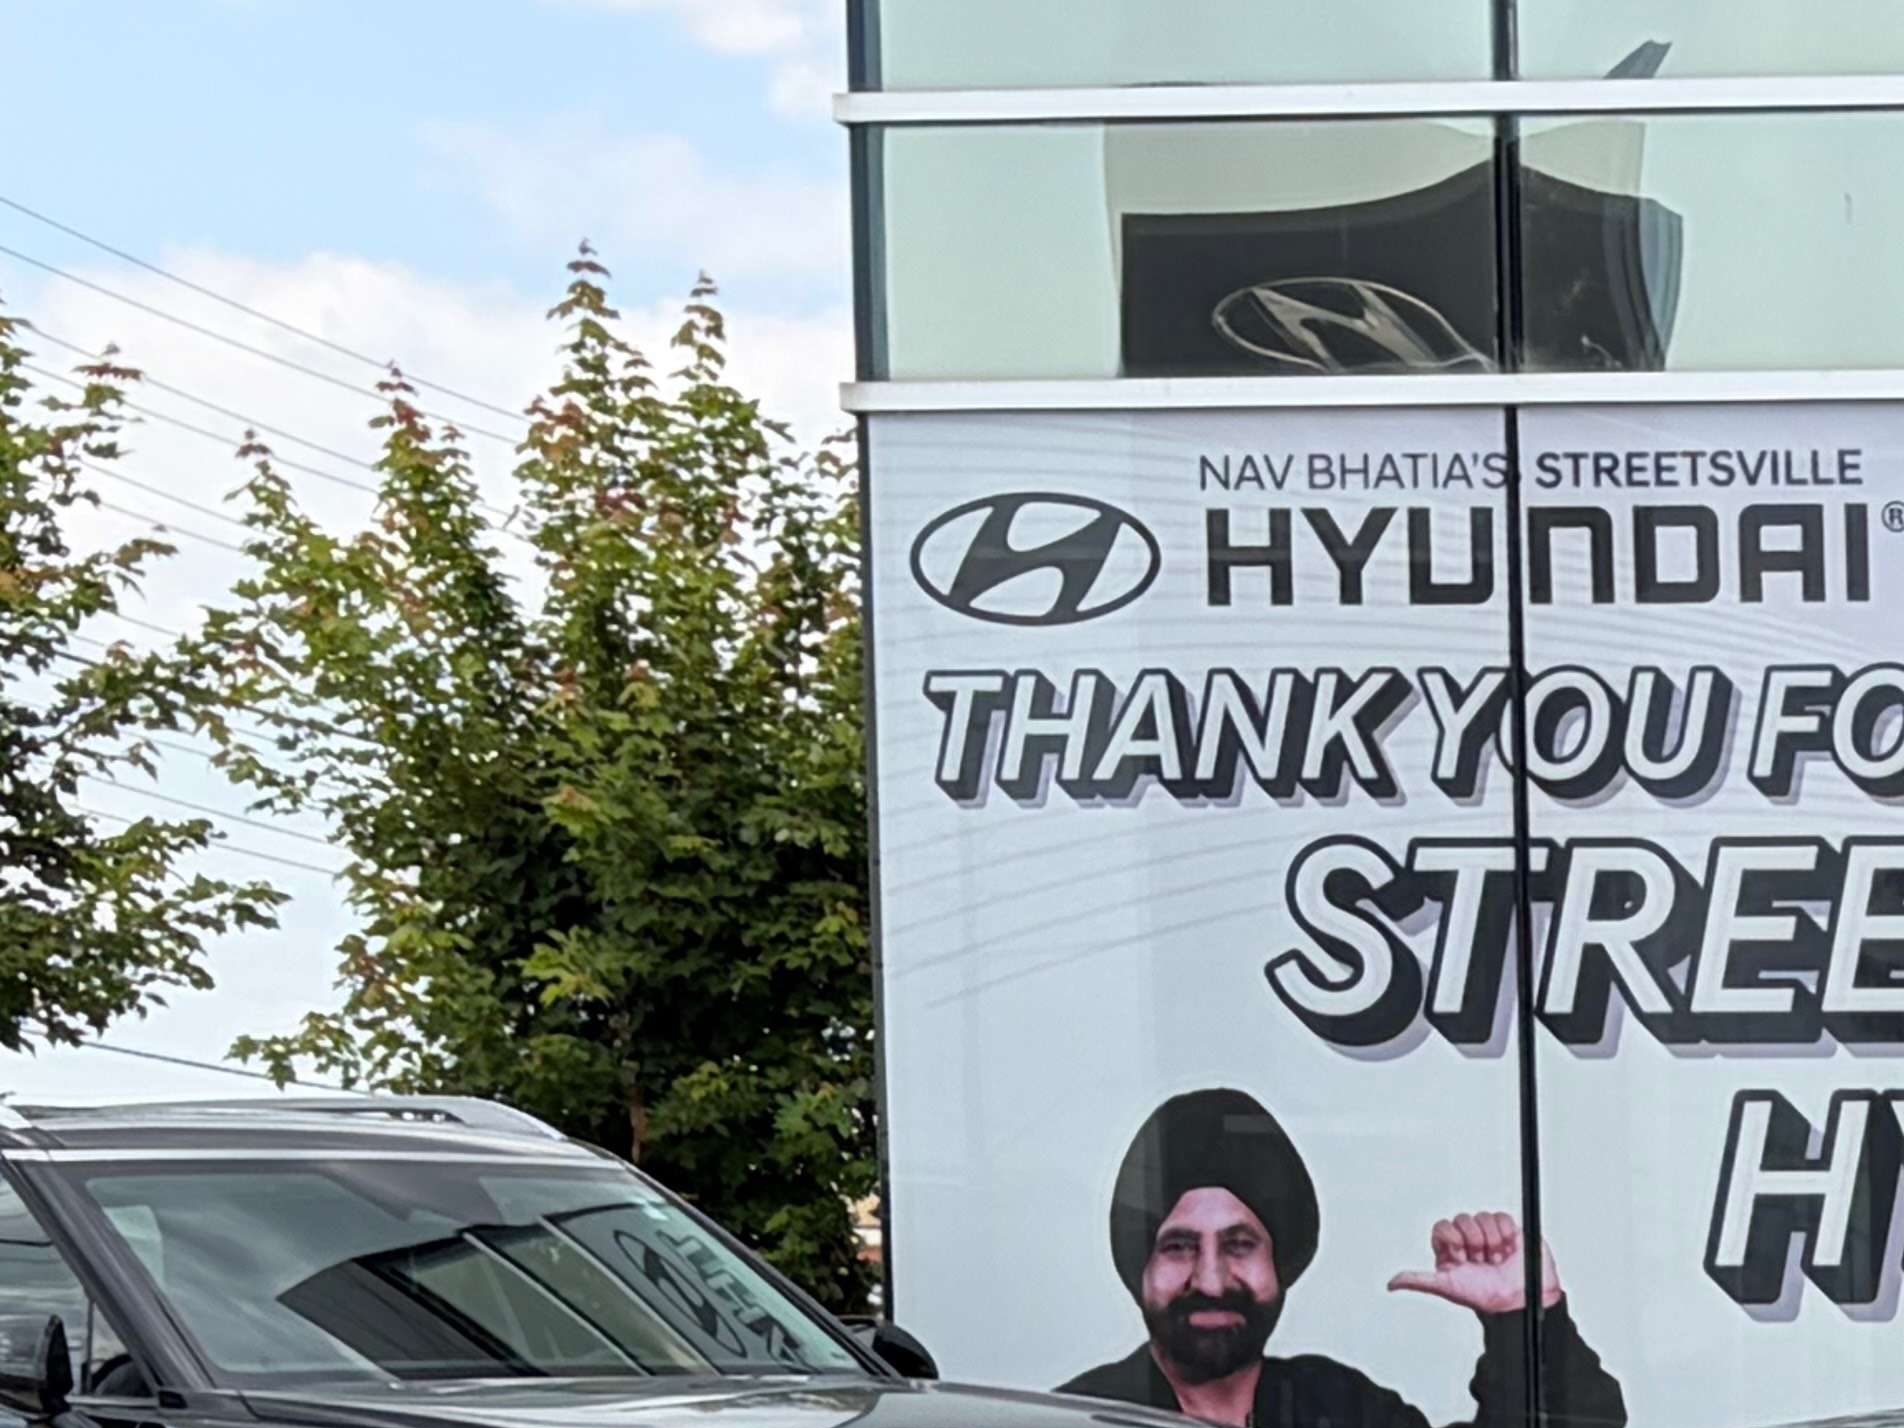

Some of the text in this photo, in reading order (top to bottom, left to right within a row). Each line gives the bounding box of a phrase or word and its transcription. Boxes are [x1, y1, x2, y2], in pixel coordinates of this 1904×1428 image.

[1199, 449, 1864, 490] NAV BHATIA'S STREETSVILLE
[924, 667, 1412, 800] THANK
[1418, 663, 1730, 798] YOU
